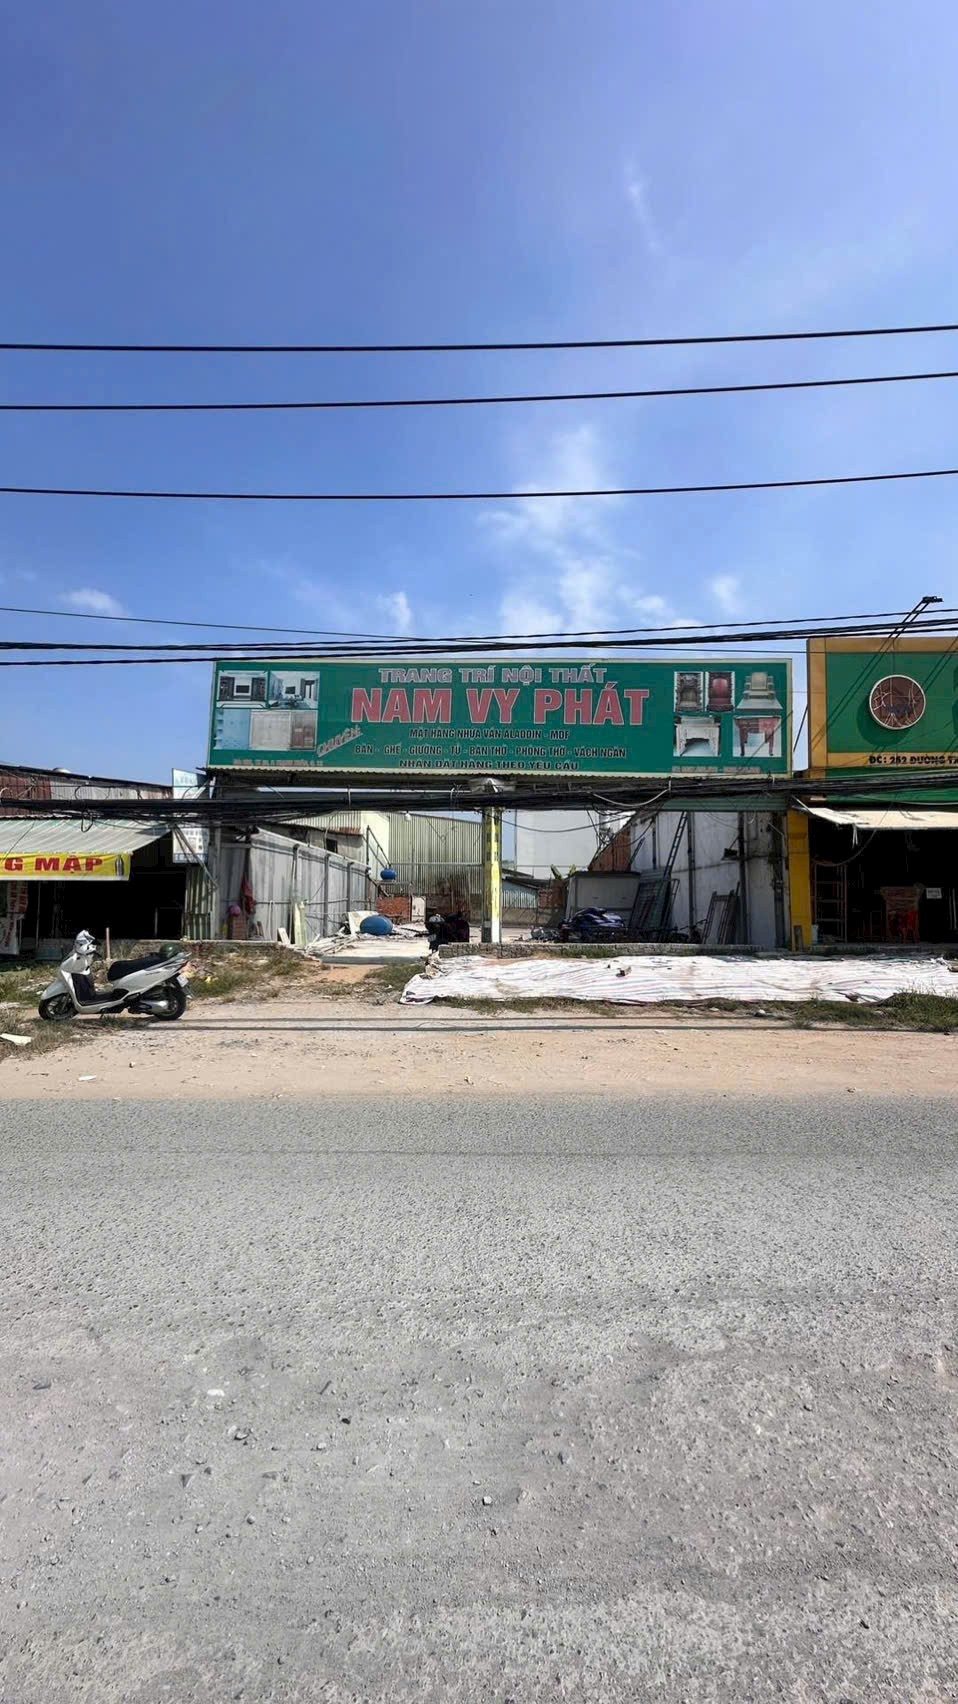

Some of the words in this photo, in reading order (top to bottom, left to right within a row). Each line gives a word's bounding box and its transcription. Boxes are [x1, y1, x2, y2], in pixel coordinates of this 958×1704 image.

[379, 667, 453, 683] TRANG
[459, 665, 497, 683] TRÍ
[501, 664, 542, 685] NỘI
[549, 663, 607, 684] THẤT
[351, 687, 453, 723] NAM
[466, 688, 520, 724] VY
[533, 681, 650, 725] PHÁT
[410, 727, 429, 740] MẶT
[431, 727, 454, 739] HÀNG
[457, 729, 480, 740] NHỰA
[503, 730, 541, 740] ALADDIN
[550, 730, 569, 740] MDF
[355, 743, 373, 755] BÀN
[384, 742, 401, 755] GHẾ
[409, 743, 441, 756] GIƯỜNG
[469, 744, 488, 757] BÀN
[491, 744, 507, 757] THỜ
[516, 744, 546, 757] PHÒNG
[549, 745, 566, 757] THỜ
[574, 746, 598, 758] VÁCH
[600, 746, 626, 759] NGĂN
[399, 759, 431, 770] NHẬN
[460, 759, 492, 770] HÀNG
[496, 760, 525, 770] THEO
[529, 759, 551, 770] YÊU
[4, 857, 23, 871] G
[35, 855, 103, 873] MẬP
